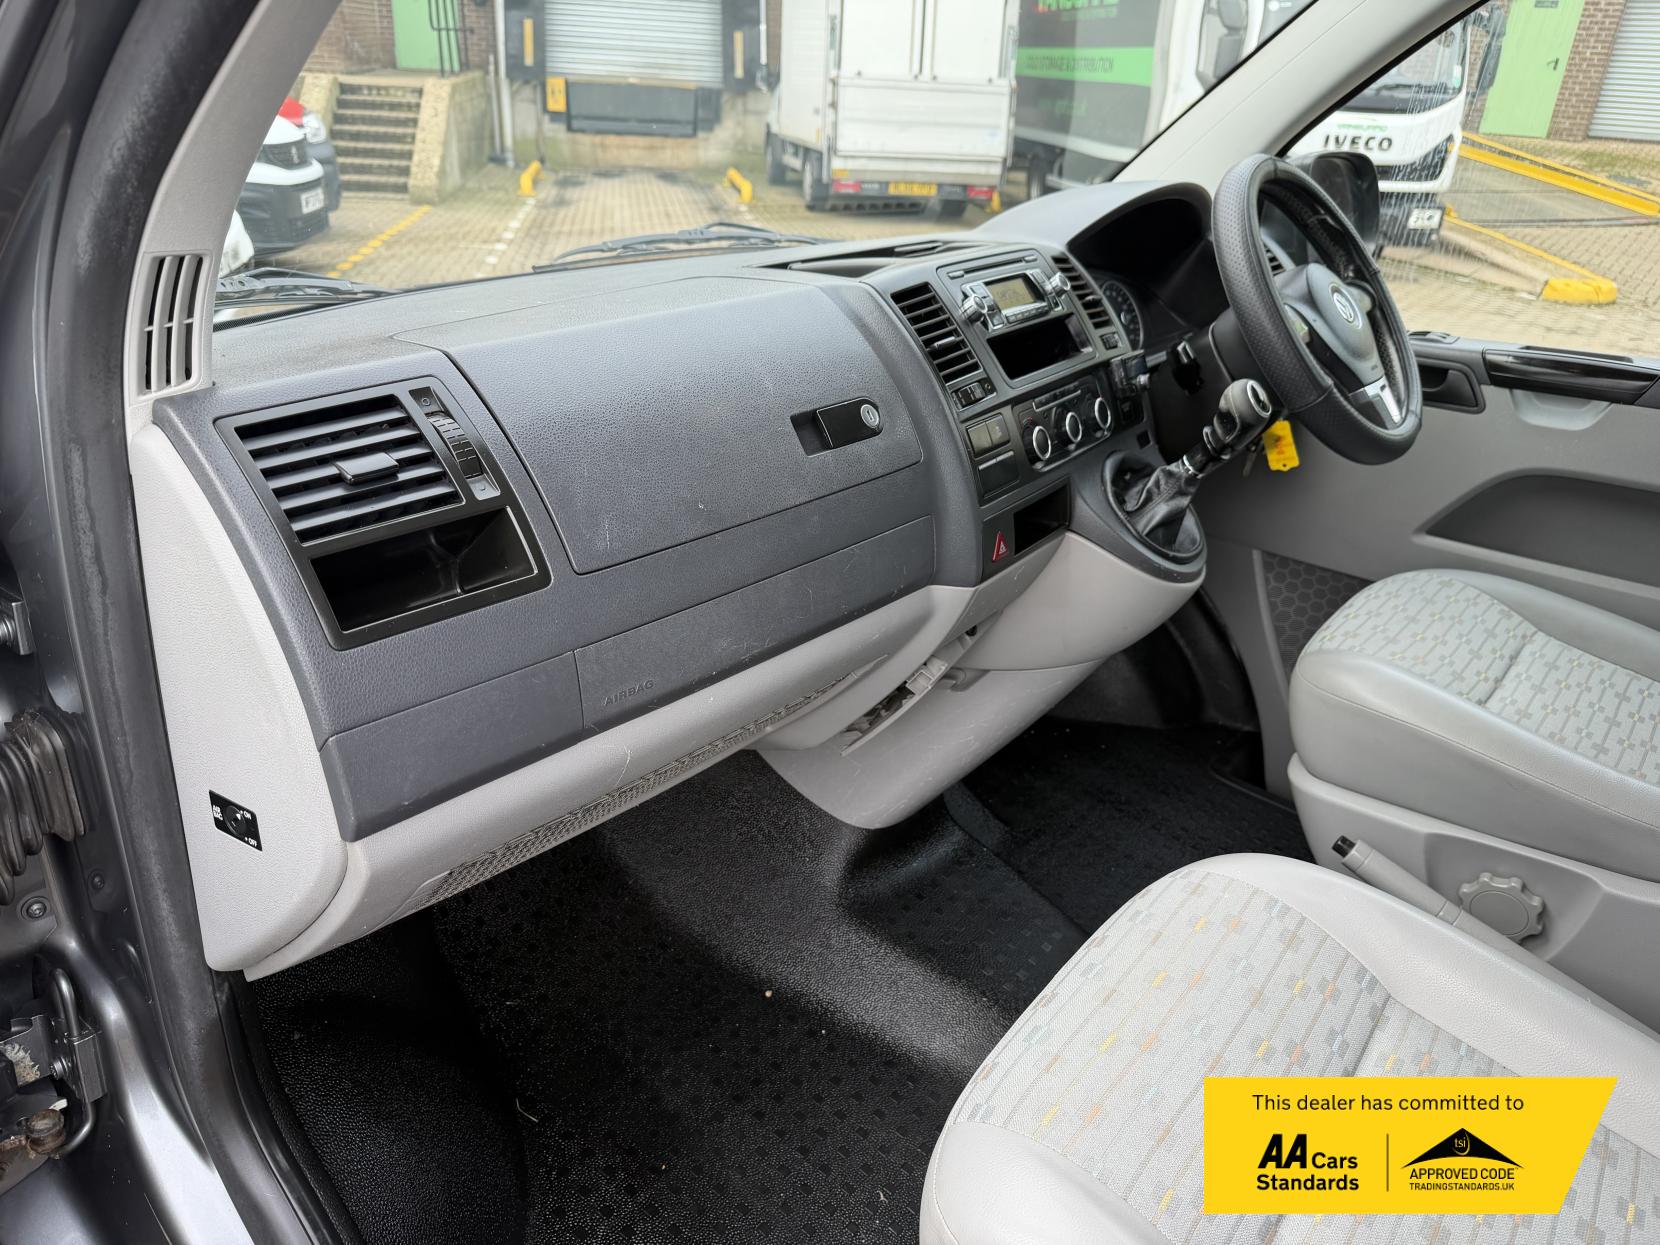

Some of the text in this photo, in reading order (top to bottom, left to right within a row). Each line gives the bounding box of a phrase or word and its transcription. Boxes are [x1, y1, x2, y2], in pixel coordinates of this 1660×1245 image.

[1324, 134, 1393, 151] IVECO
[602, 679, 655, 706] AIRBAG
[243, 811, 252, 819] ON
[248, 838, 258, 847] OFF
